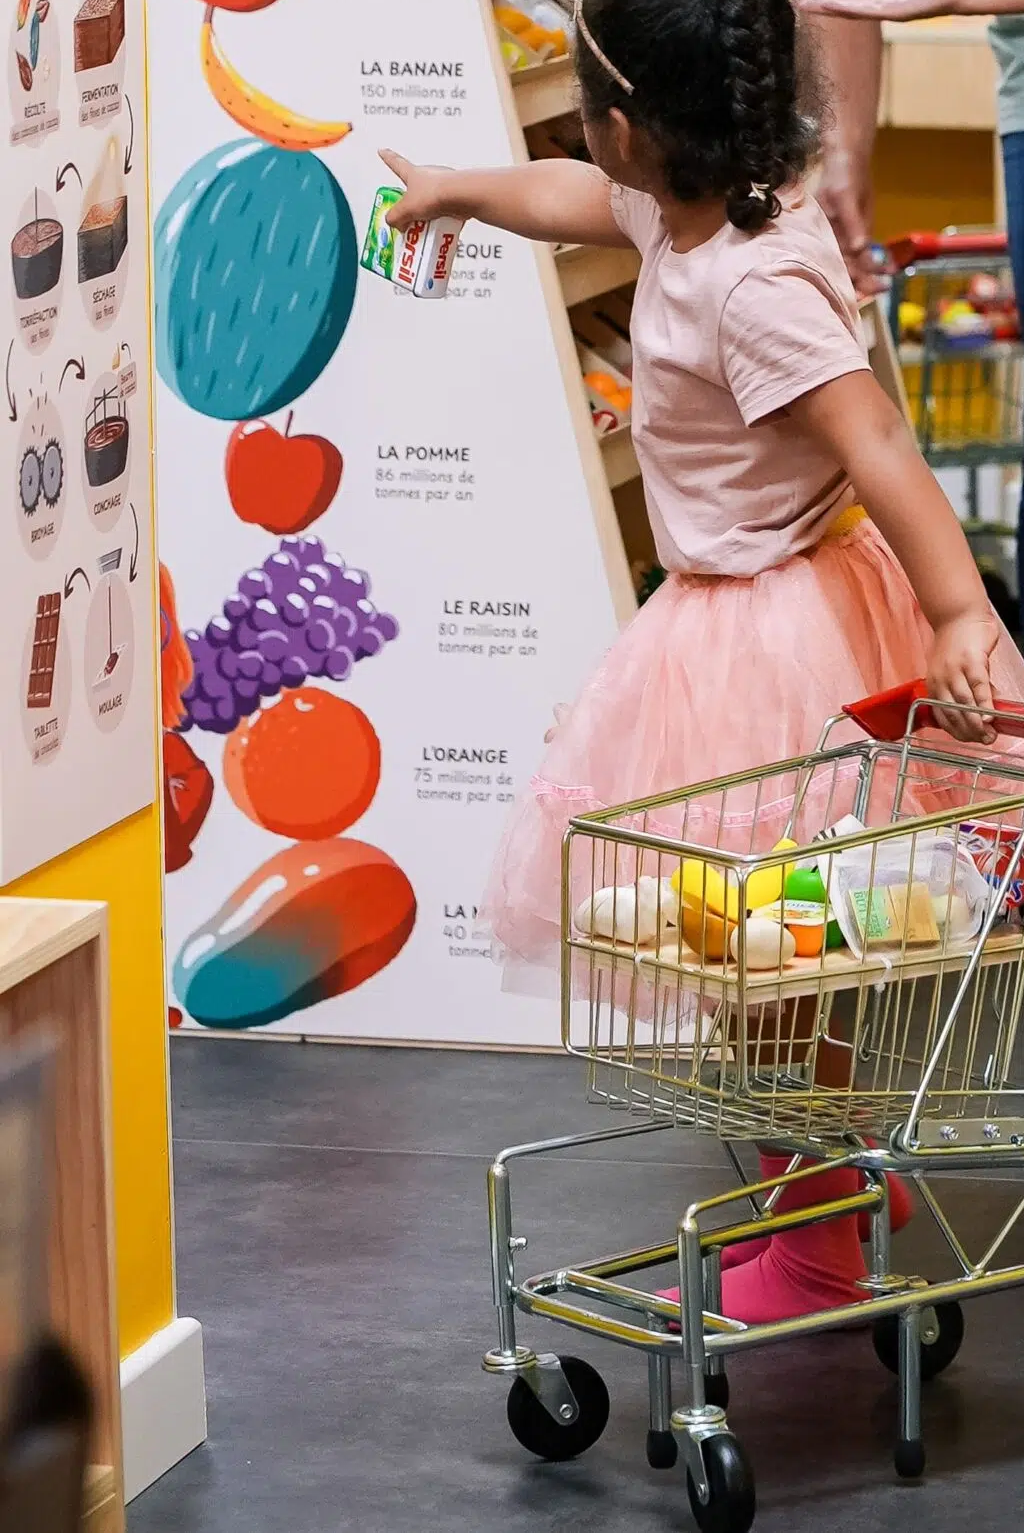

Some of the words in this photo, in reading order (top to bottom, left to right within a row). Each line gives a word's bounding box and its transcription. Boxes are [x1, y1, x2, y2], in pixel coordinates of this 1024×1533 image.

[361, 60, 383, 75] LA
[390, 61, 464, 77] BANANE
[392, 84, 445, 99] millions
[450, 85, 467, 99] de
[363, 103, 408, 116] tonnes
[414, 105, 438, 119] par
[443, 105, 462, 116] an
[398, 219, 427, 284] Persil
[433, 233, 455, 279] Persil
[457, 239, 503, 260] ÈQUE
[480, 267, 497, 281] de
[474, 287, 492, 298] an
[378, 445, 399, 460] LA
[405, 446, 470, 462] POMME
[458, 469, 475, 484] de
[375, 487, 420, 499] tonnes
[425, 489, 450, 503] par
[455, 490, 474, 501] an
[444, 600, 464, 615] LE
[470, 601, 530, 617] RAISIN
[521, 624, 538, 639] de
[438, 642, 483, 654] tonnes
[488, 644, 514, 657] par
[518, 645, 537, 656] an
[423, 746, 508, 764] L'ORANGE
[414, 767, 432, 782] 75
[496, 771, 513, 786] de
[416, 788, 462, 800] tonnes
[467, 791, 491, 805] par
[496, 792, 515, 803] an
[444, 904, 467, 919] LA
